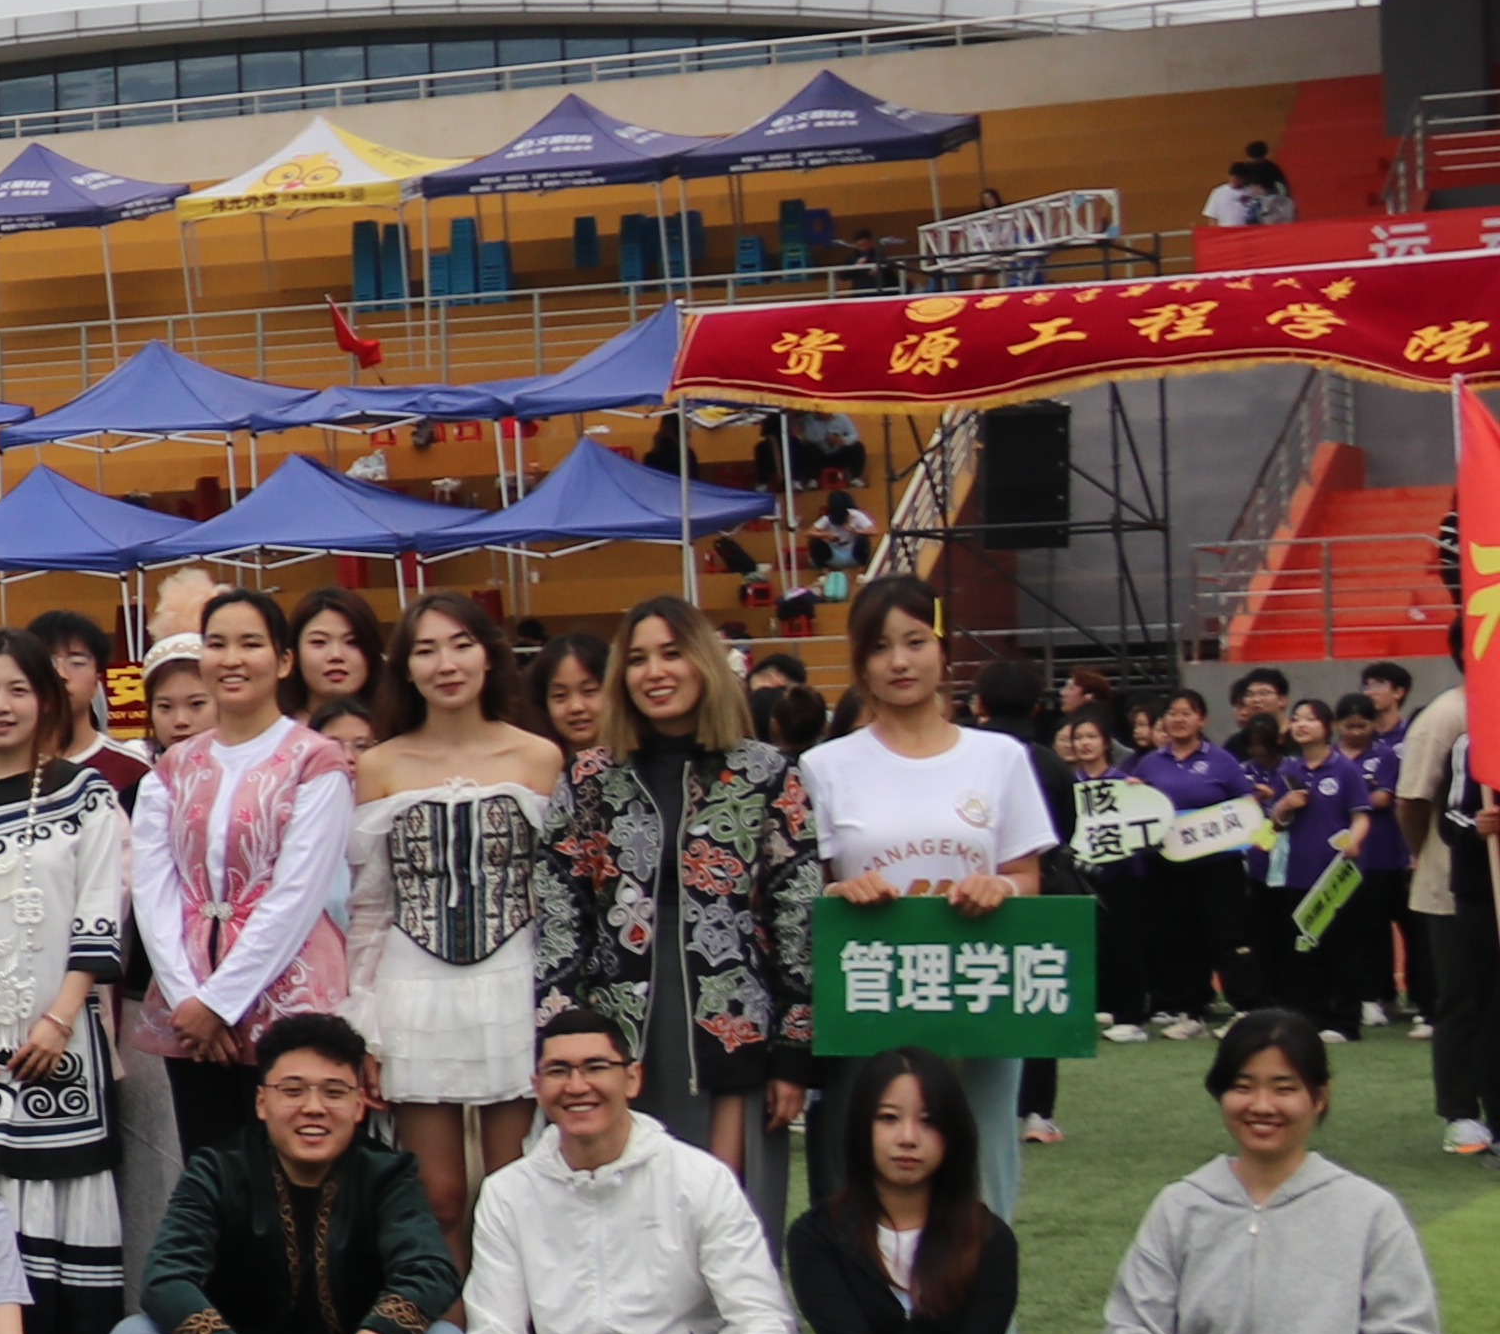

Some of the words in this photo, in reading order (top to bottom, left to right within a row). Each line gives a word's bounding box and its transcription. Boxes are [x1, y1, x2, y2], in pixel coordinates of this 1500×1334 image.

[771, 299, 1491, 382] 资源工程学院
[840, 941, 1071, 1015] 管理学院
